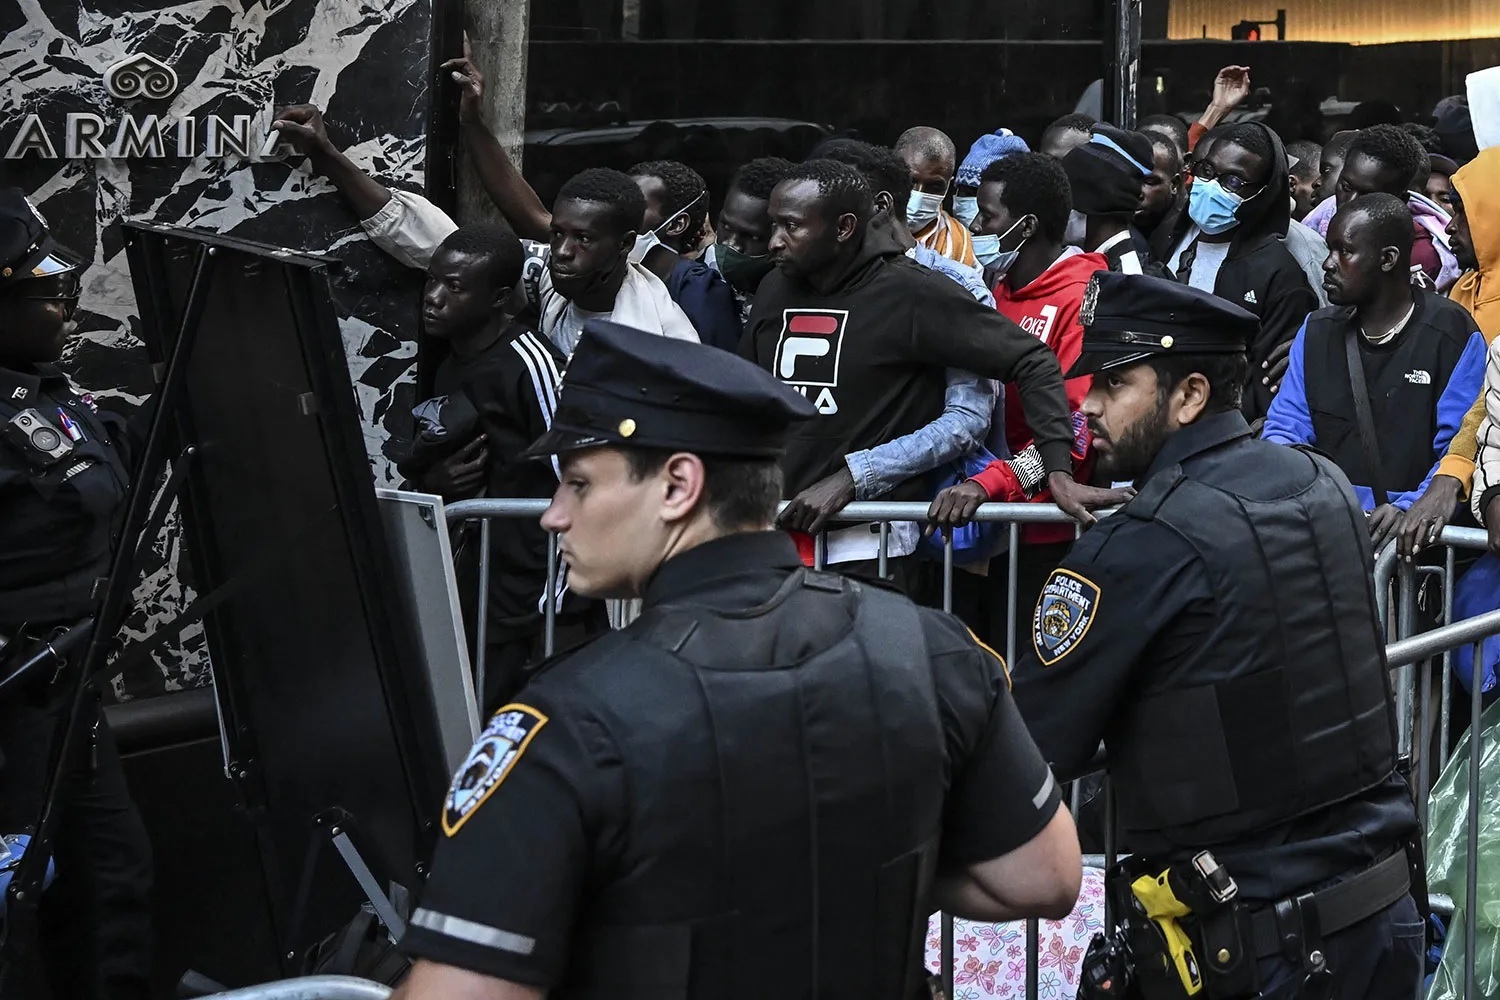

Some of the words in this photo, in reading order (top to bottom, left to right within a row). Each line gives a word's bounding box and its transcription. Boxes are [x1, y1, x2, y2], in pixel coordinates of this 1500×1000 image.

[1044, 584, 1091, 611] DEPARTMENT
[1055, 575, 1082, 593] POLICE
[1053, 639, 1071, 656] NEW
[1070, 615, 1090, 640] YORK
